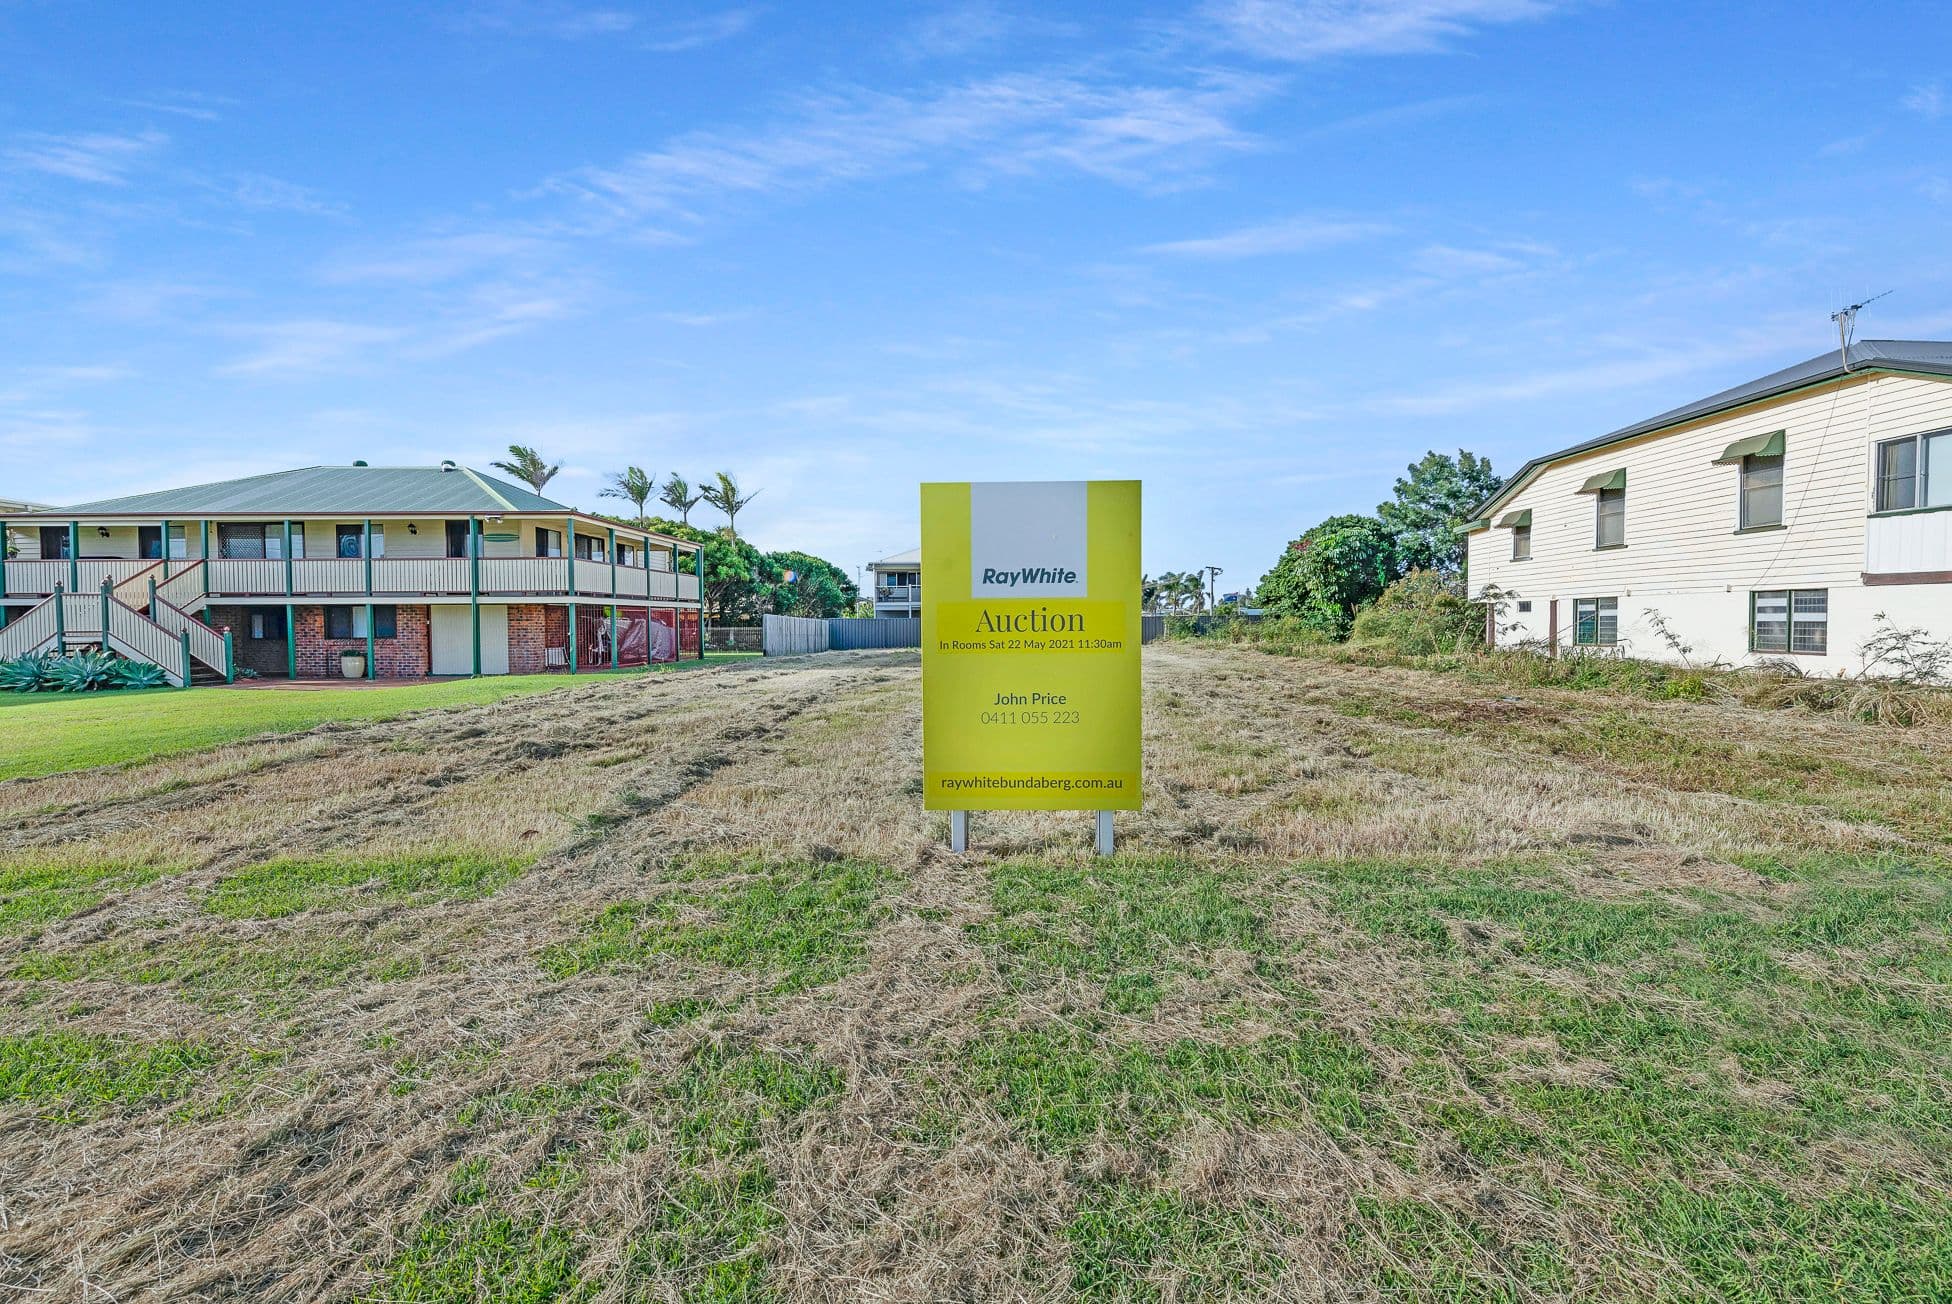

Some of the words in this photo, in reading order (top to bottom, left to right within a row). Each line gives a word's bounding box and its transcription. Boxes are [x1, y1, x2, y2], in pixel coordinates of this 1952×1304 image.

[975, 607, 1086, 633] Auction
[939, 641, 949, 650] In
[952, 640, 987, 650] Rooms
[989, 640, 1005, 650] Sat
[1008, 639, 1021, 649] 22
[1024, 639, 1046, 651] May
[1049, 639, 1075, 649] 2021
[1078, 638, 1122, 649] 11:30am
[994, 693, 1028, 705] John
[1032, 693, 1067, 705] Price
[981, 712, 1016, 724] 0411
[1021, 712, 1048, 724] 055
[1053, 711, 1080, 724] 223
[941, 776, 1123, 790] raywhitebundaberg.com.au
